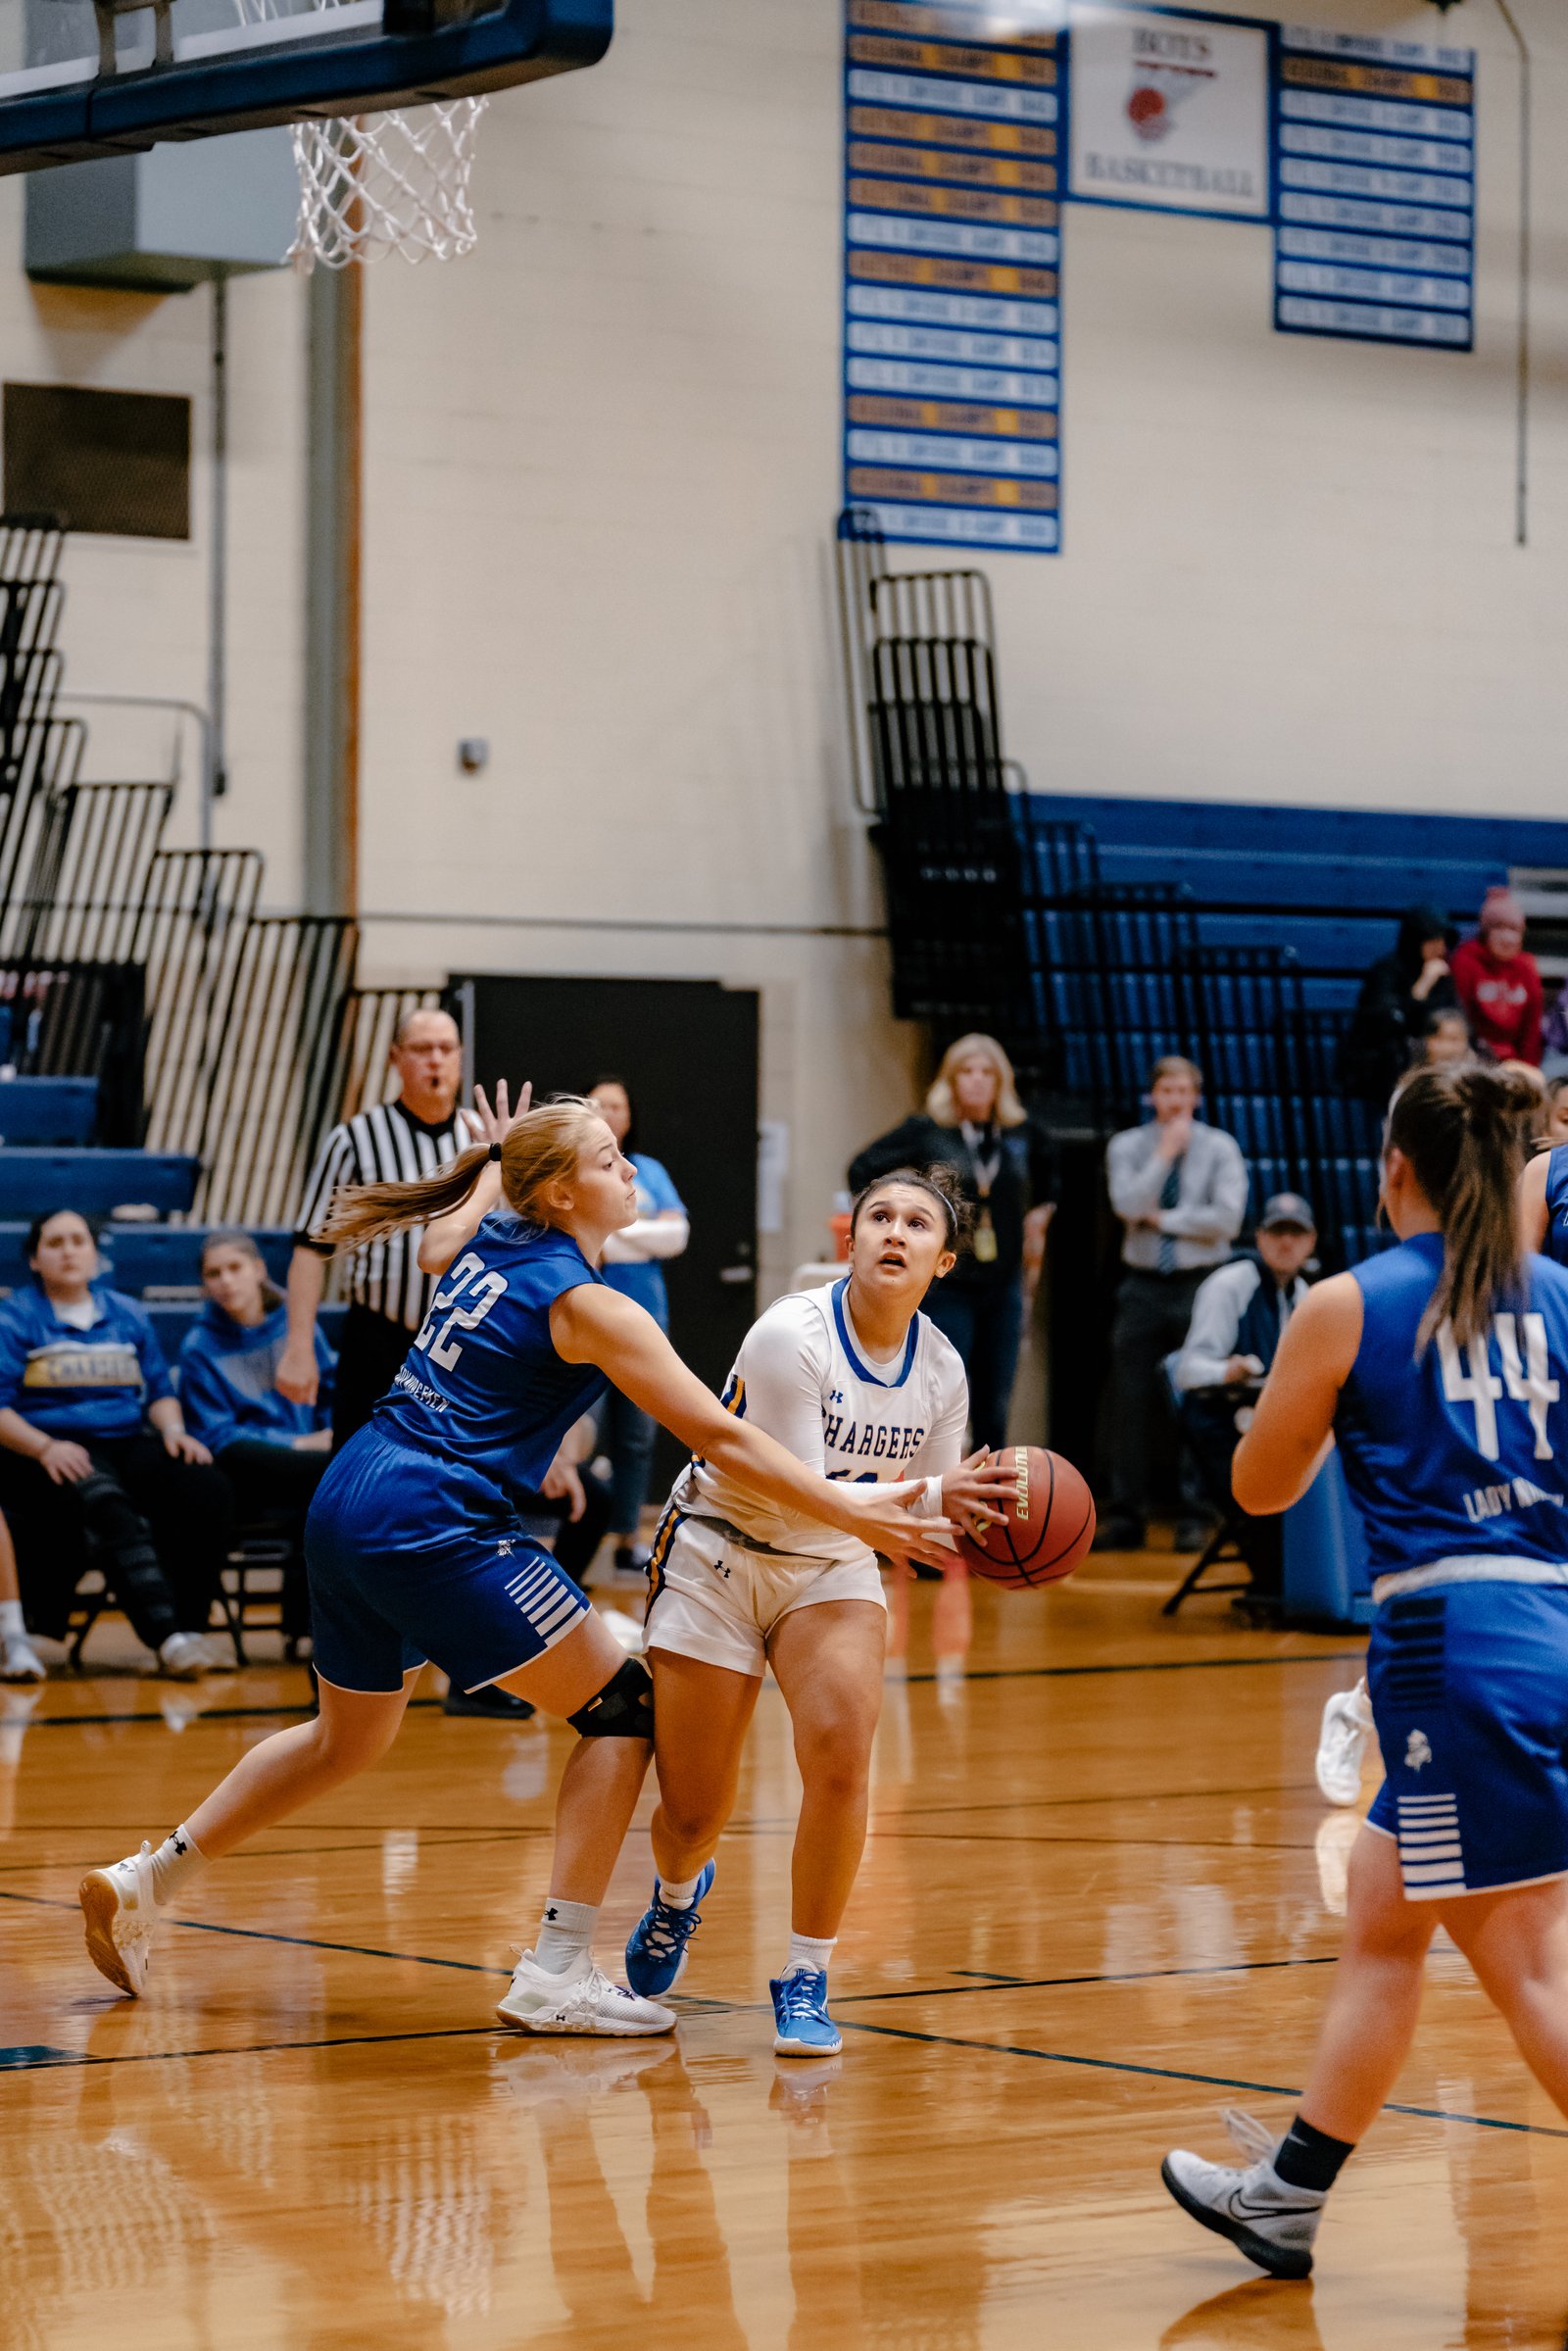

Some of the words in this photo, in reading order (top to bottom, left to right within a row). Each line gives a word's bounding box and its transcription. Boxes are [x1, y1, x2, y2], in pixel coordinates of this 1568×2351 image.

[1086, 151, 1252, 197] BASKETBALL
[413, 1251, 509, 1372] 22
[1436, 1311, 1560, 1461] 44
[1463, 1483, 1512, 1524] LADY
